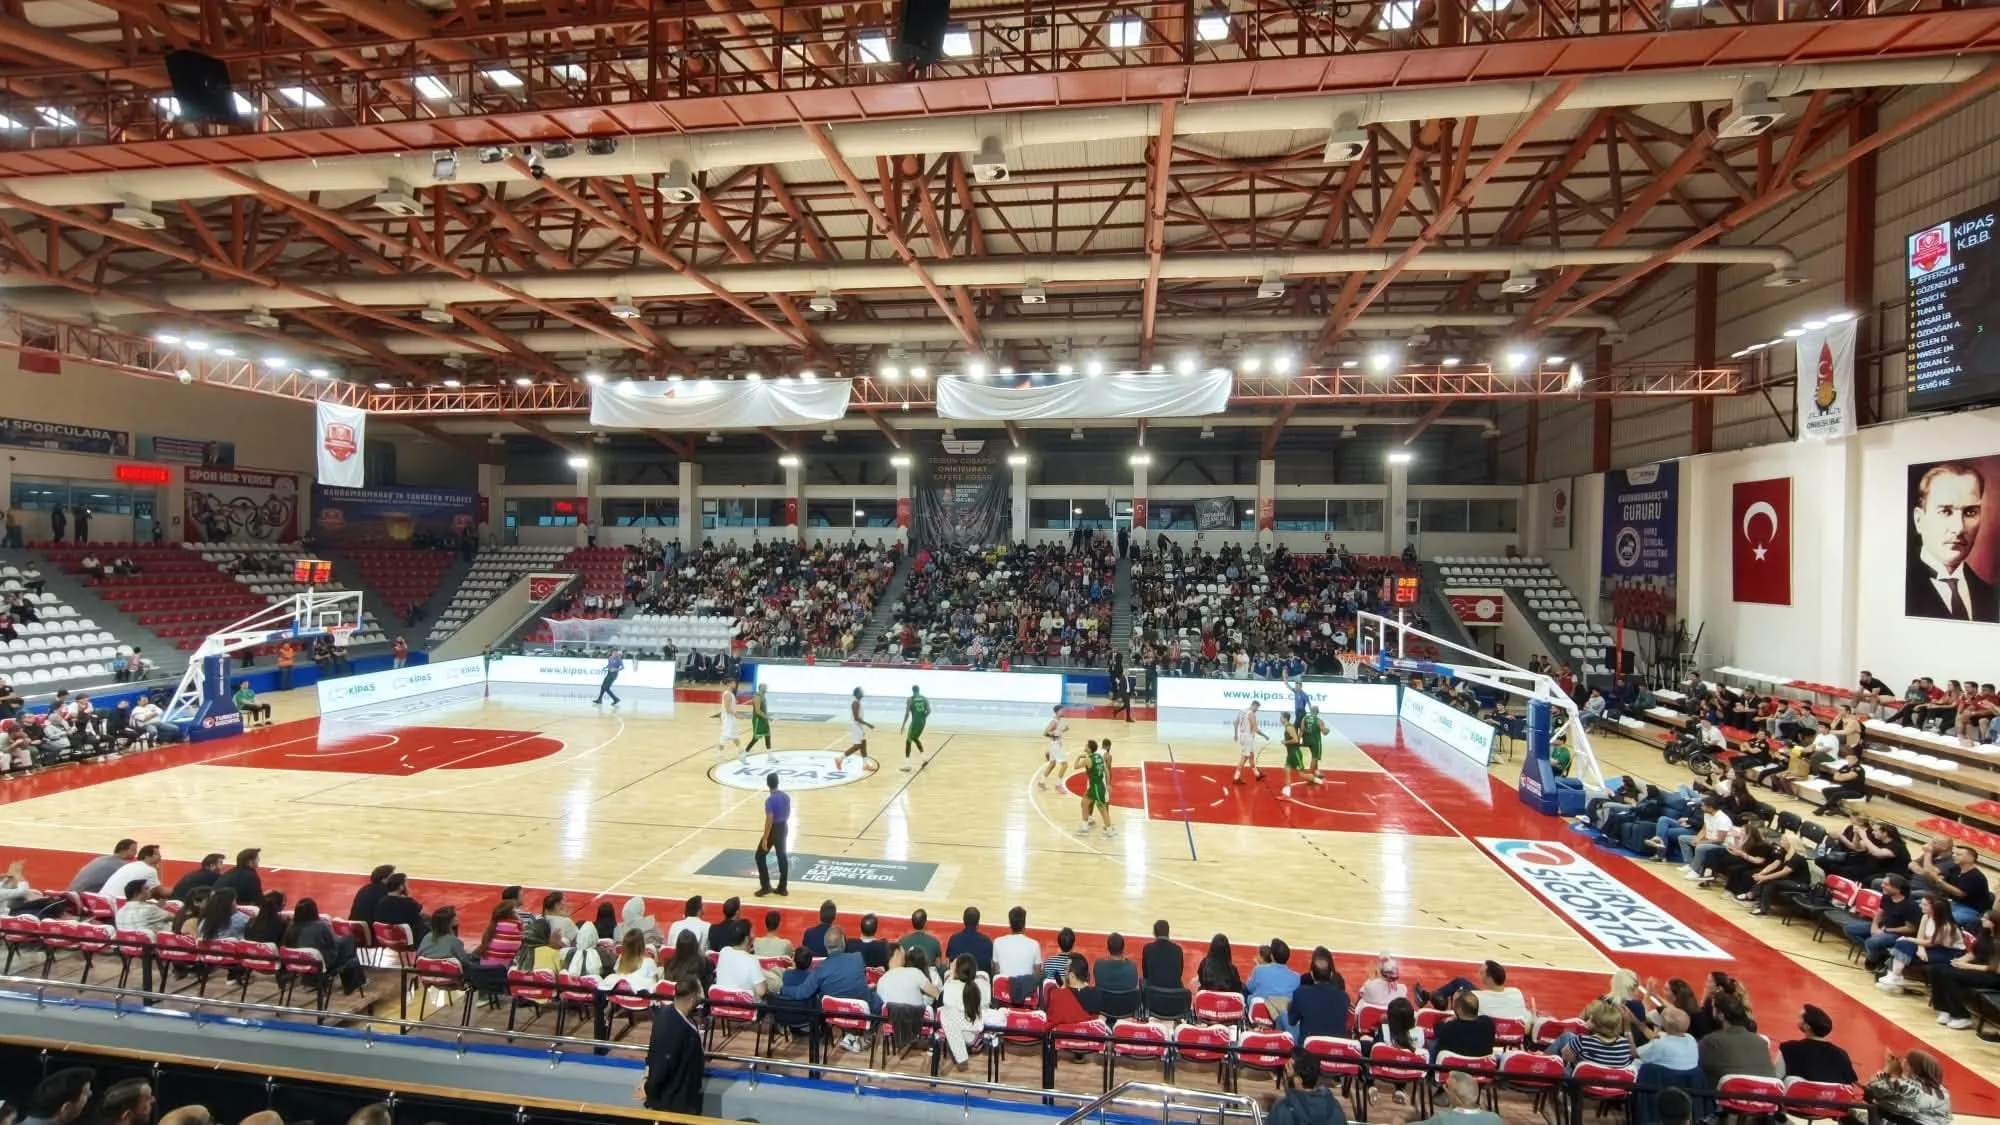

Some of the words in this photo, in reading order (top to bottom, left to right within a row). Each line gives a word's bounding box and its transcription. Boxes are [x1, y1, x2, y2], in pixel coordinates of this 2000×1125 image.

[12, 419, 112, 441] SPORCULARA
[189, 469, 217, 482] SPOR
[806, 868, 897, 882] BASKETBOL
[1523, 866, 1652, 949] SİGORTA
[1564, 870, 1710, 952] TÜRKİYE
